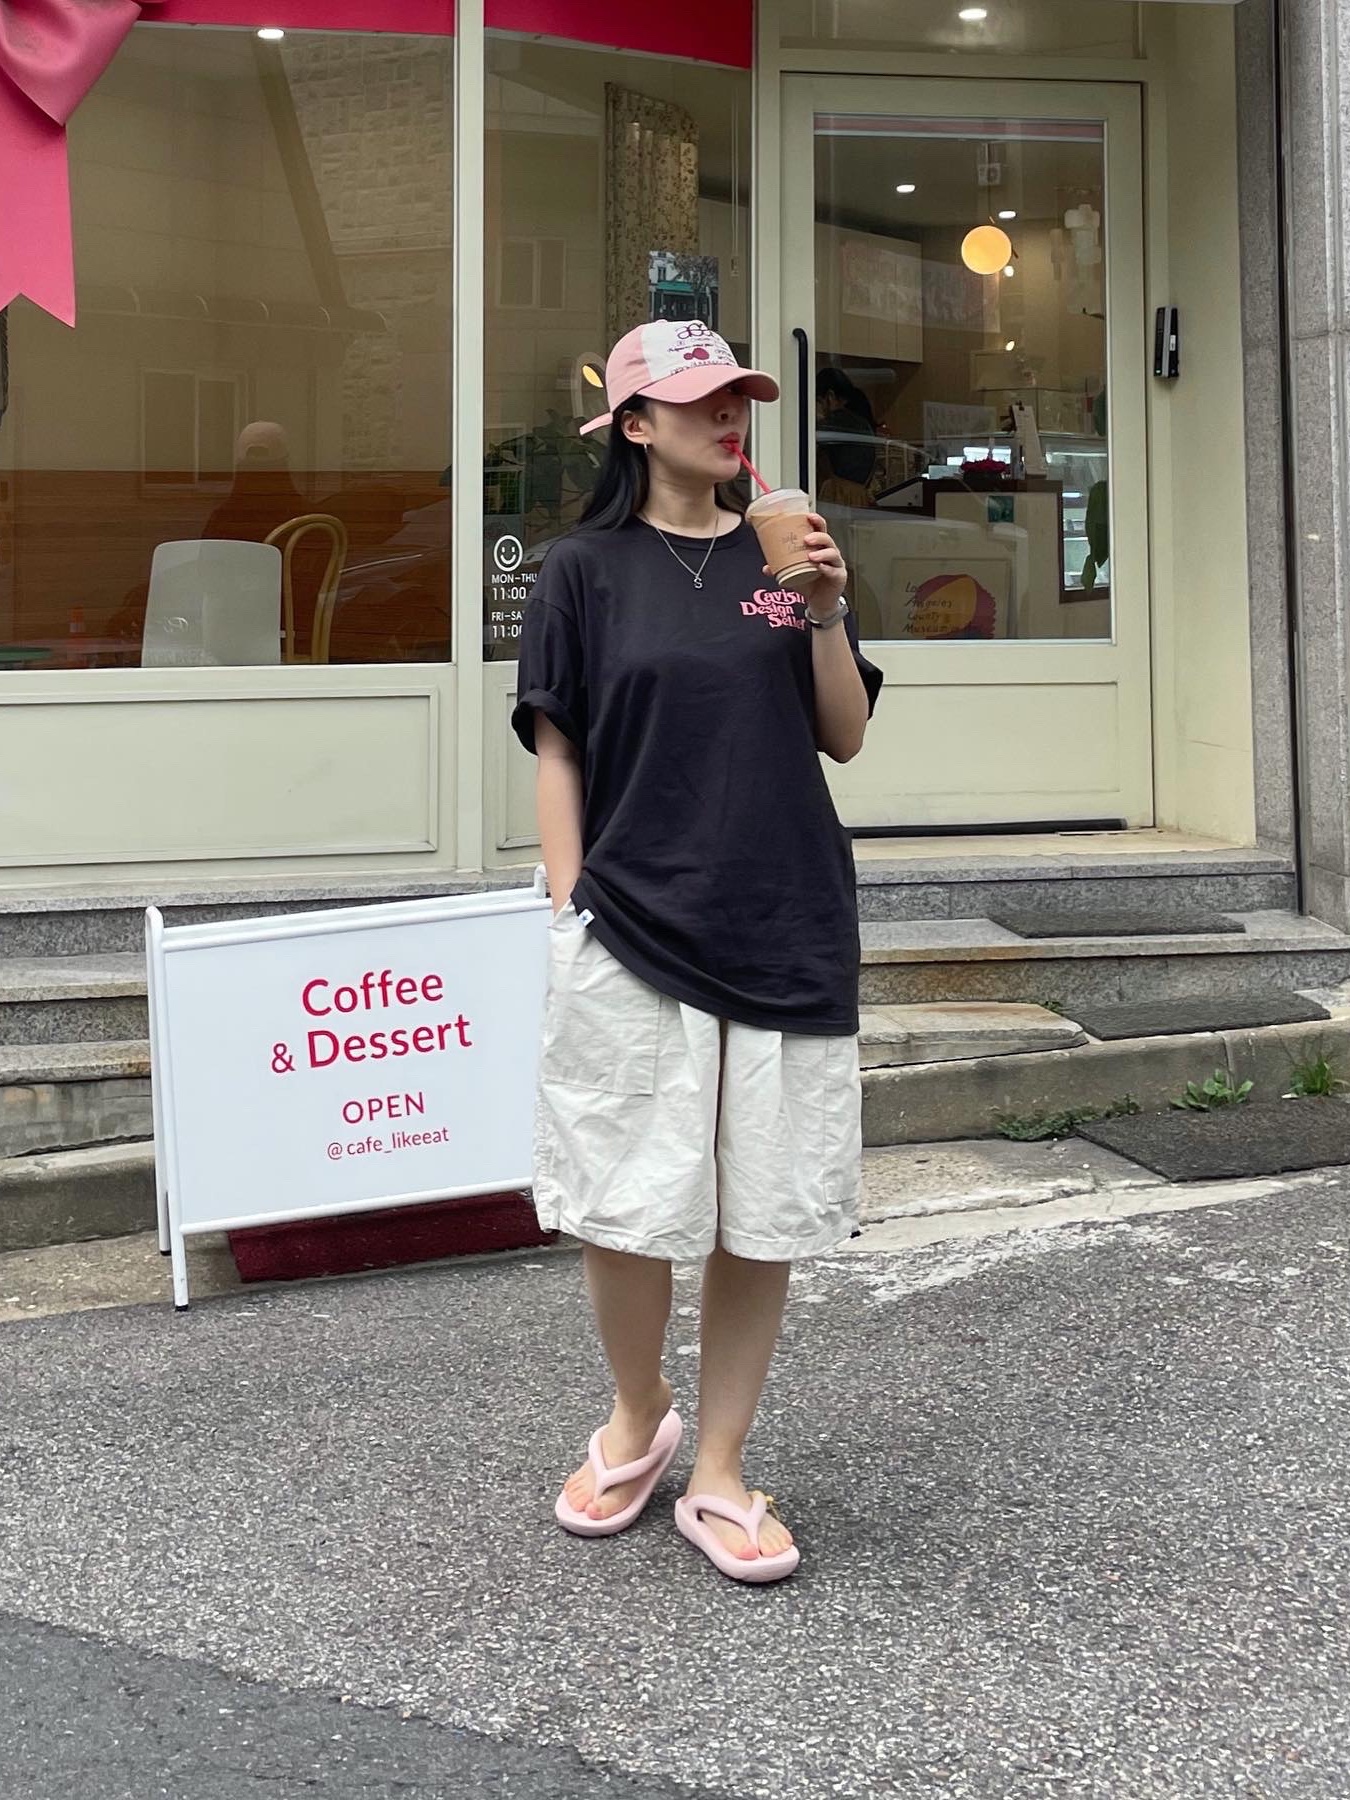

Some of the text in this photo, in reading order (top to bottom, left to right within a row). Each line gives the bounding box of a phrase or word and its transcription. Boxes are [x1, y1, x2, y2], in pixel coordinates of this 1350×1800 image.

[493, 587, 526, 600] 11:00
[491, 610, 525, 621] FRI-SA
[740, 600, 795, 617] Design
[302, 969, 444, 1017] Coffee
[271, 1013, 473, 1074] & Dessert
[342, 1091, 425, 1124] OPEN
